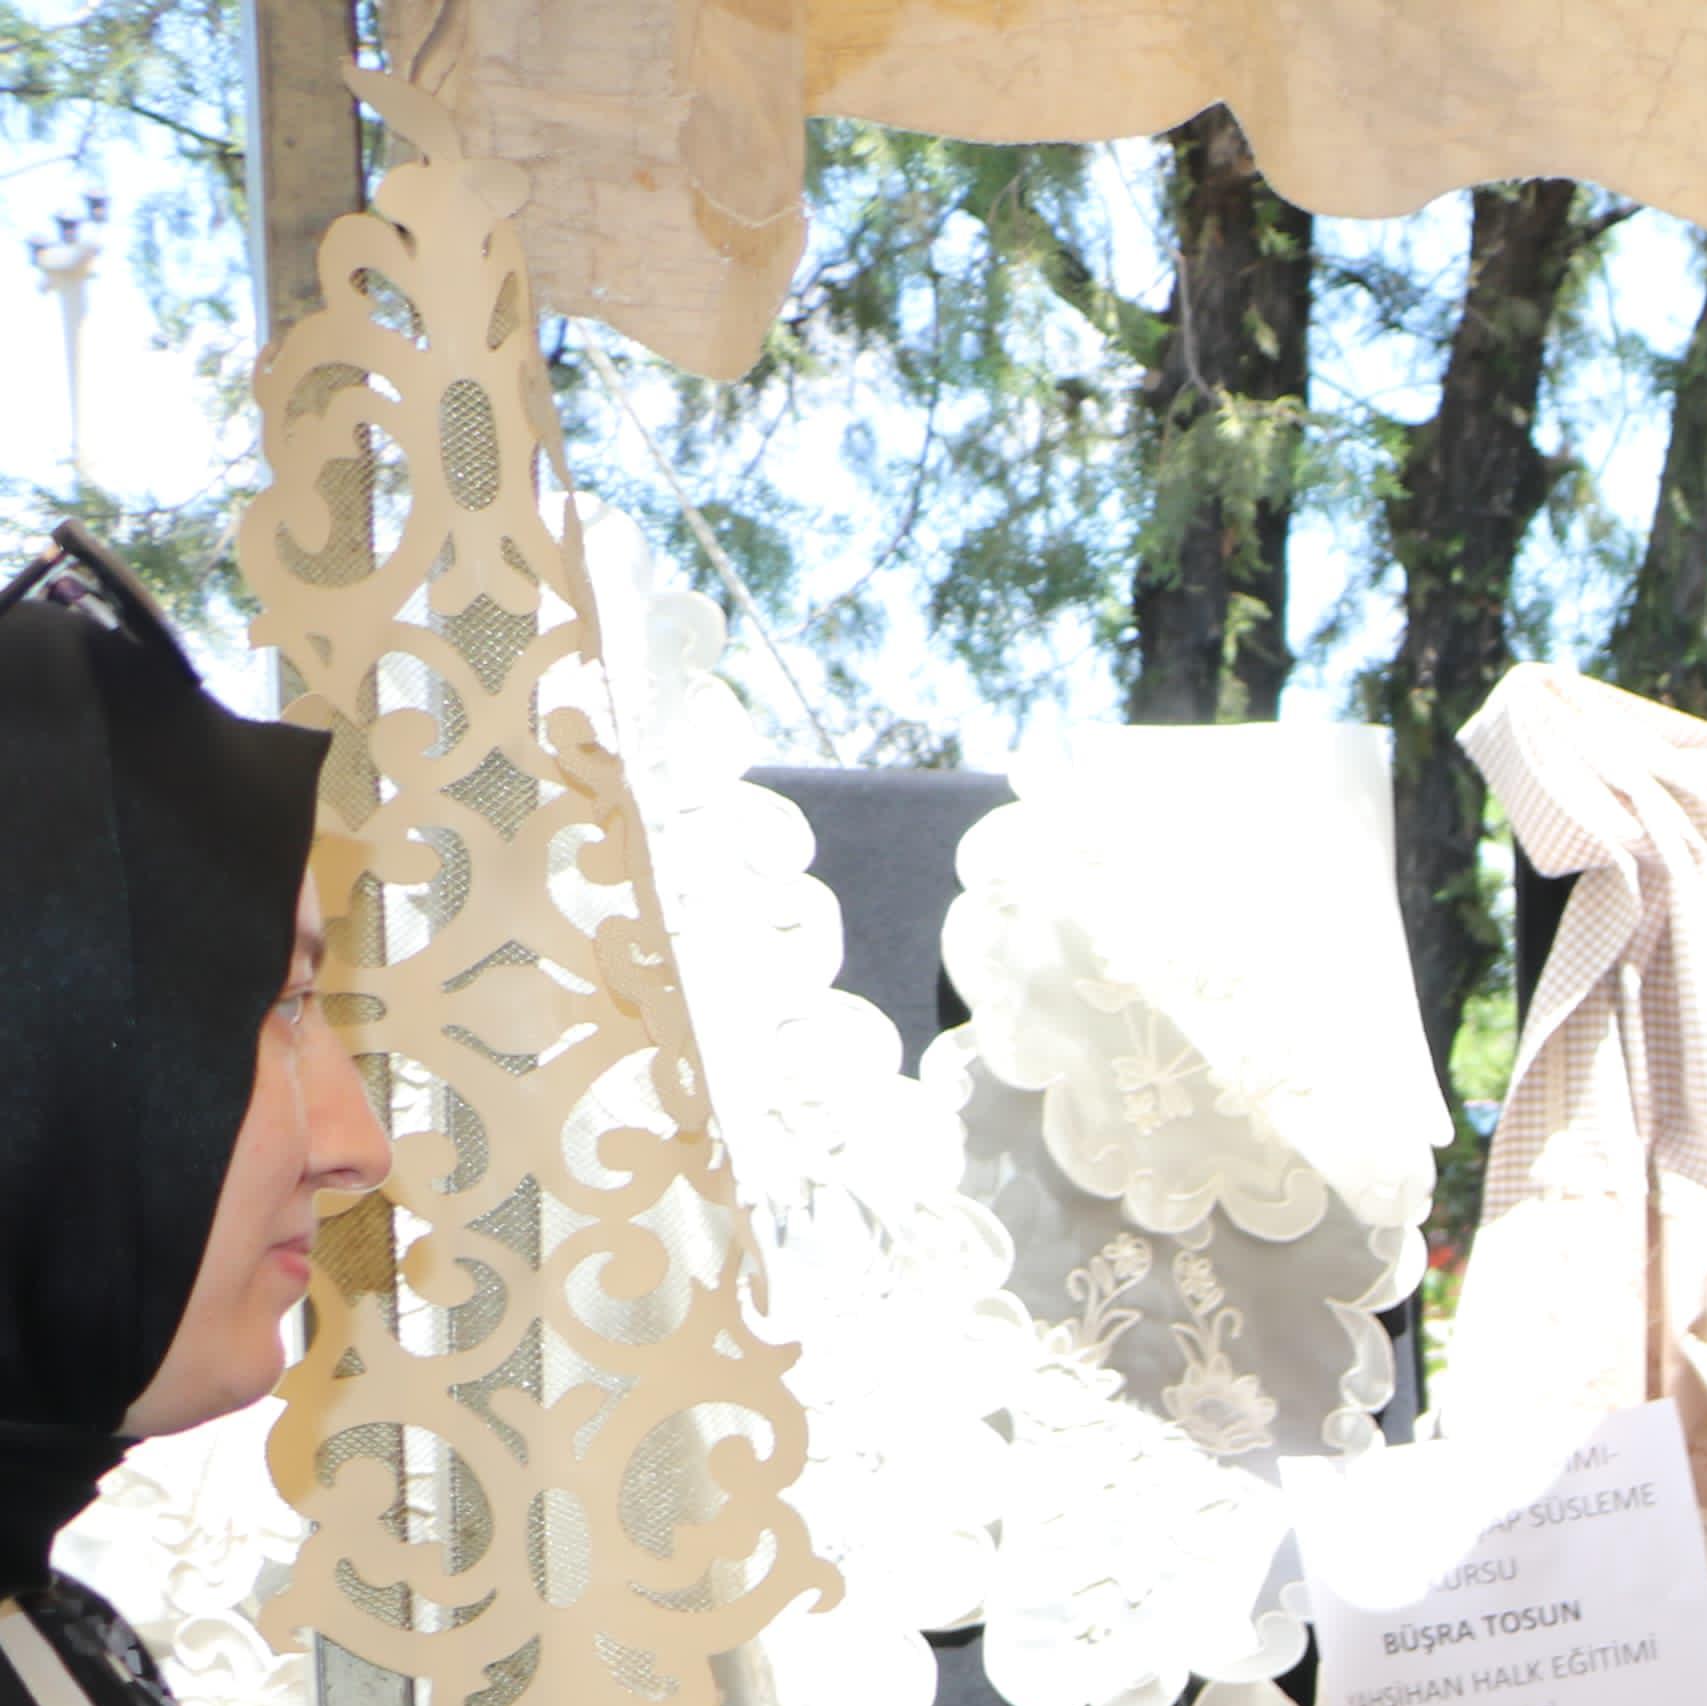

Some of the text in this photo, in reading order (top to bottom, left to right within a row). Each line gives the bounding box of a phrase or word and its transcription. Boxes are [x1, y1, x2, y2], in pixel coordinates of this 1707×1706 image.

[1527, 1482, 1656, 1529] SÜSLEME
[1430, 1556, 1519, 1592] URSU
[1382, 1599, 1583, 1657] BÜŞRA TOSUN
[1472, 1658, 1545, 1696] HALK
[1551, 1632, 1661, 1681] EĞİTİMİ
